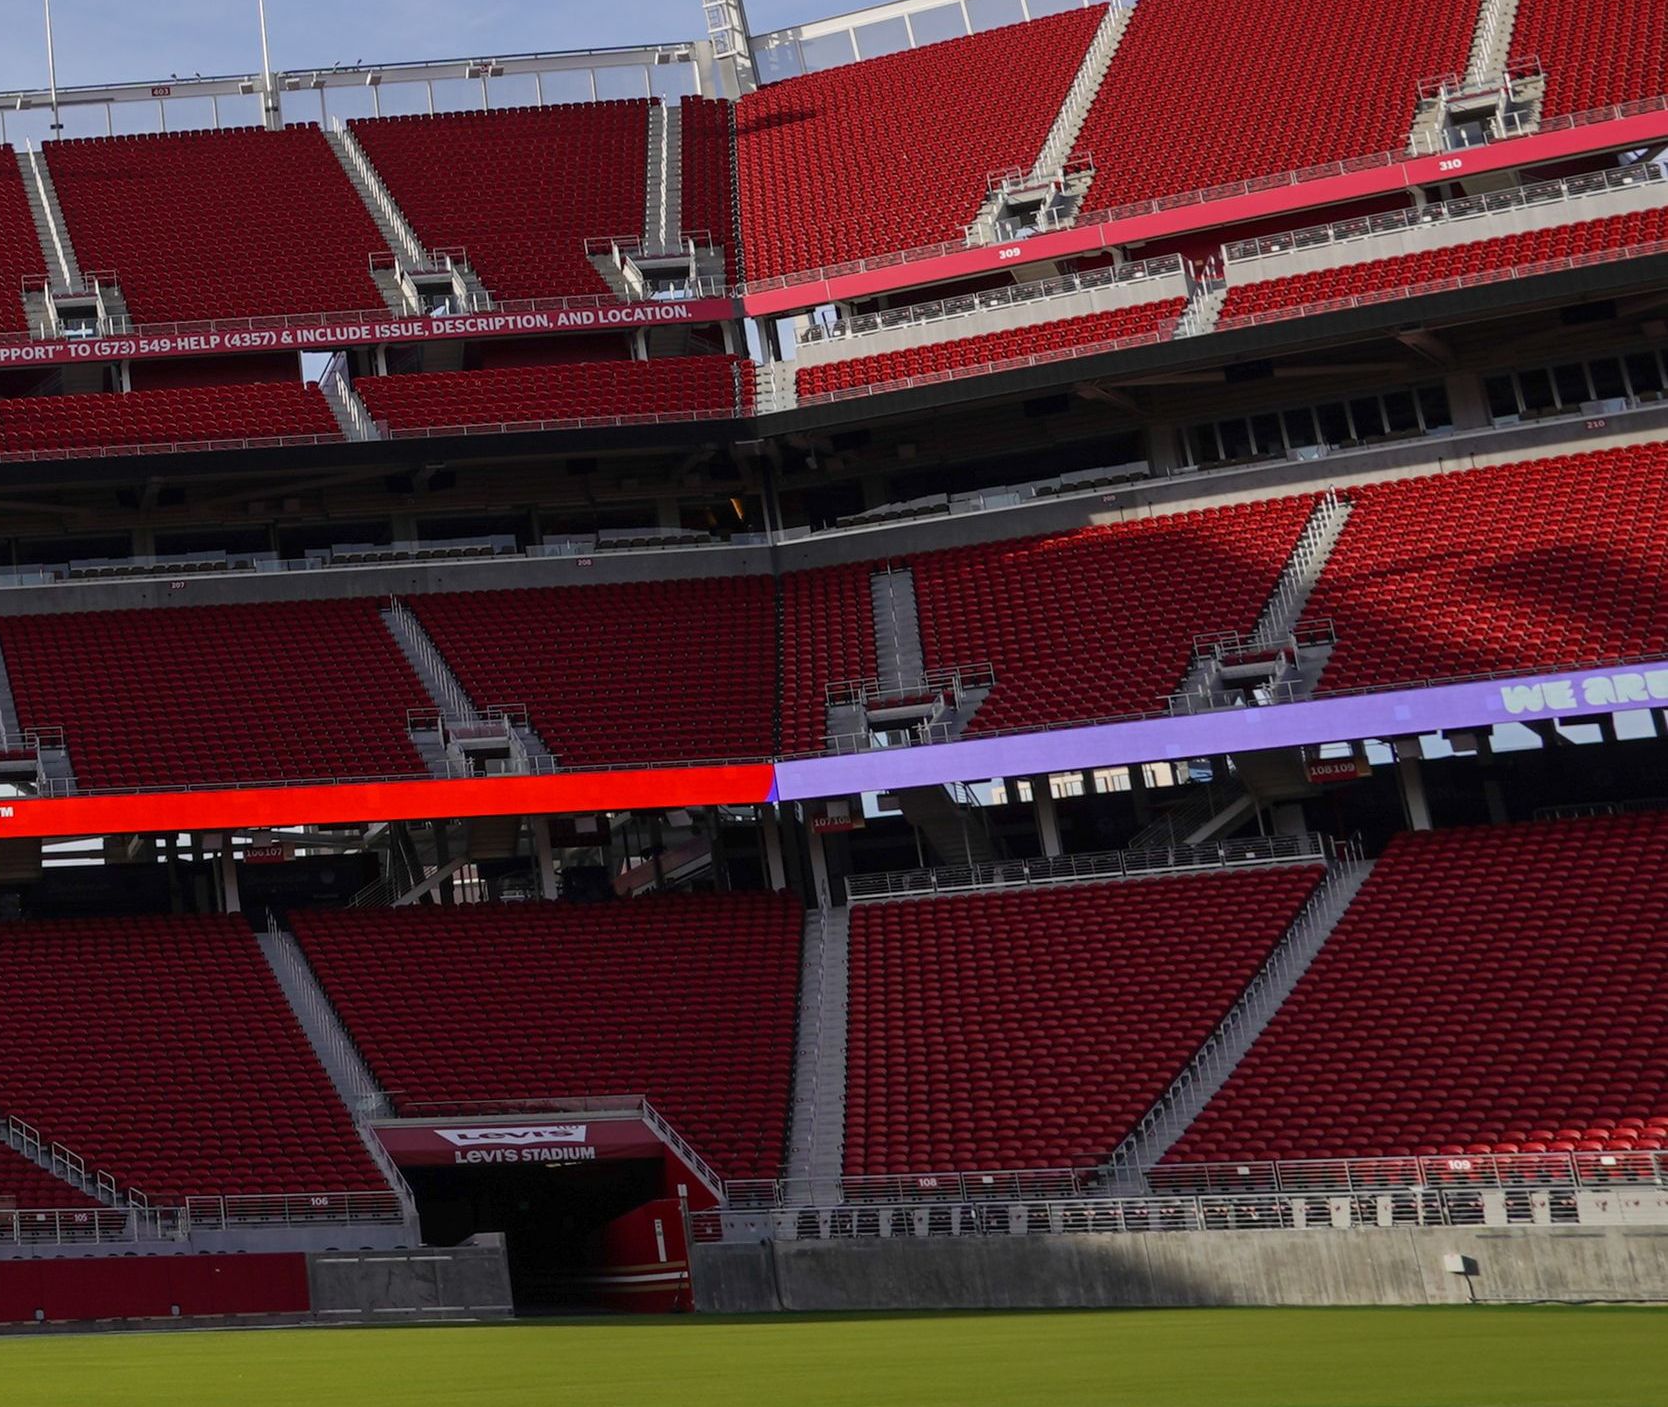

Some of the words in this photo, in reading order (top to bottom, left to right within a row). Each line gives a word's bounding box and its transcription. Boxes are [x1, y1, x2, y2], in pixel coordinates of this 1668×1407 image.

[1439, 159, 1462, 171] 310
[999, 248, 1021, 259] 309
[68, 344, 91, 358] TO
[94, 340, 136, 357] (573)
[139, 335, 221, 354] 549-HELP
[224, 330, 277, 349] (4357)
[280, 330, 293, 344] &
[296, 324, 372, 343] INCLUDE
[374, 320, 429, 339] ISSUE,
[432, 314, 554, 336] DESCRIPTION,
[557, 310, 595, 326] AND
[598, 304, 693, 323] LOCATION.
[1500, 680, 1578, 714] WE
[521, 1146, 596, 1161] STADIUM
[1448, 1159, 1471, 1169] 109
